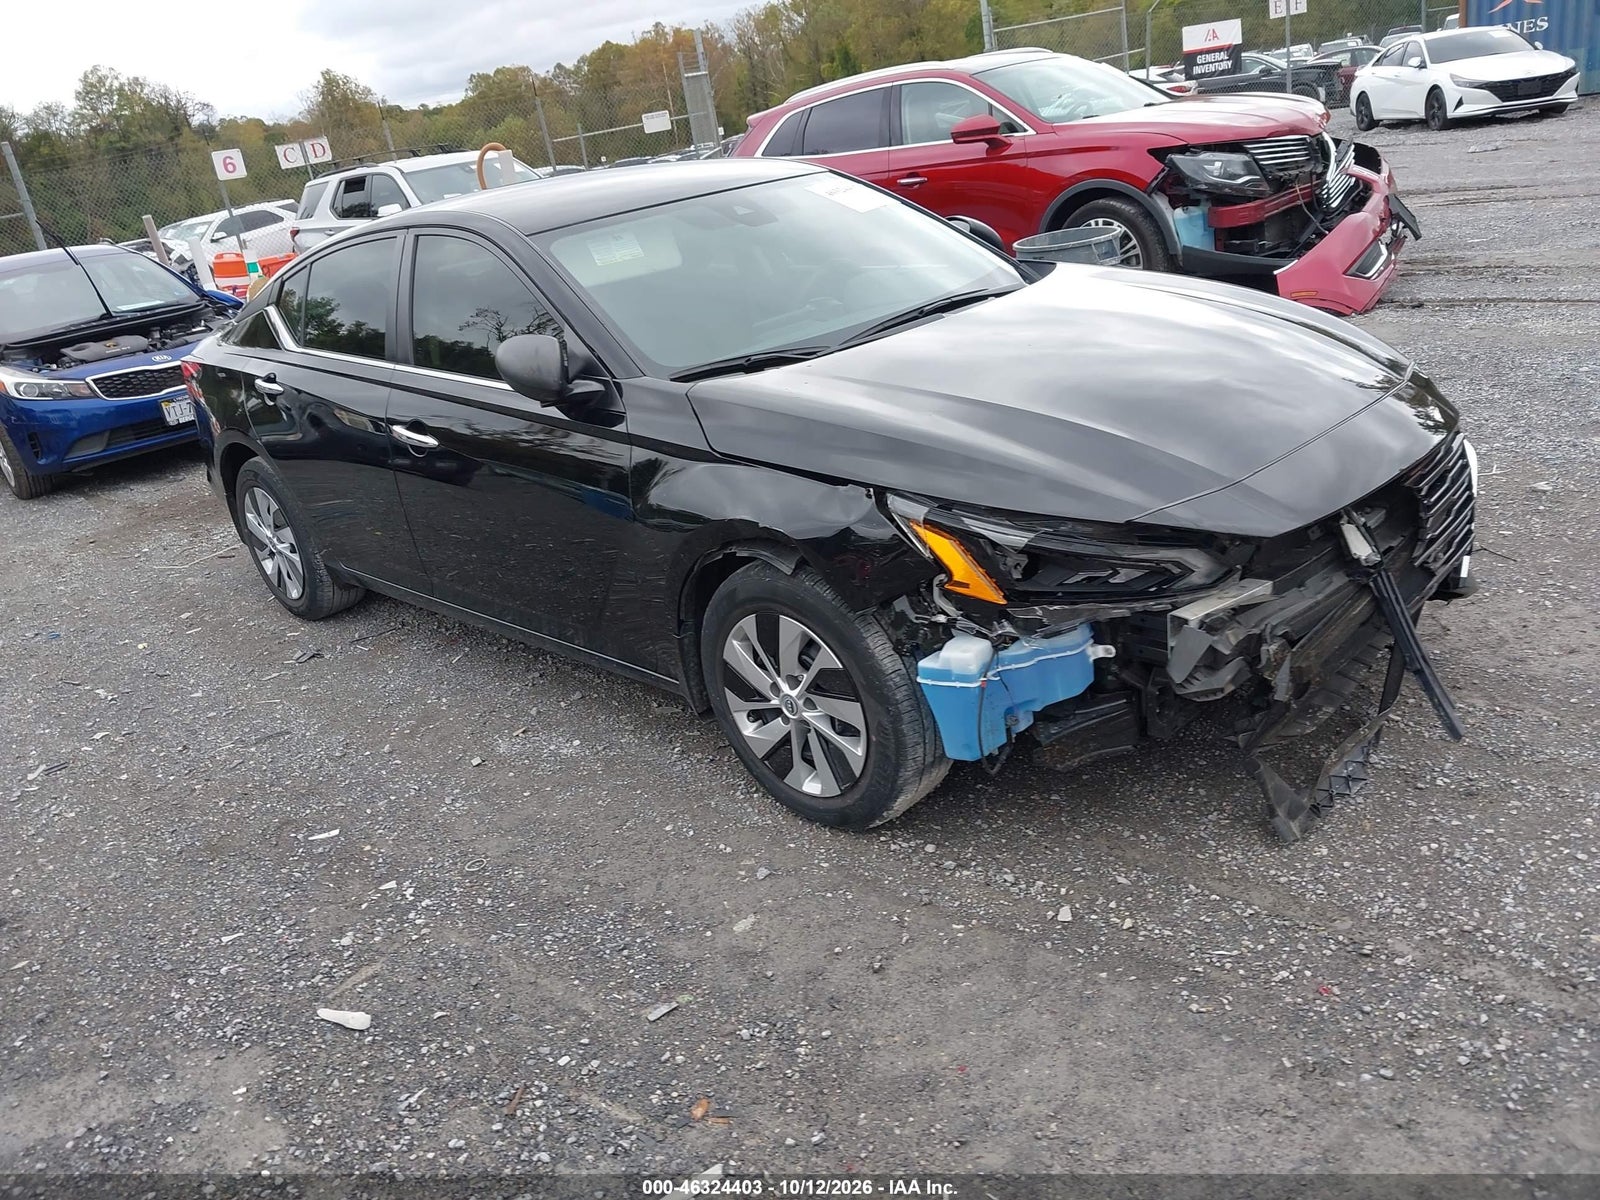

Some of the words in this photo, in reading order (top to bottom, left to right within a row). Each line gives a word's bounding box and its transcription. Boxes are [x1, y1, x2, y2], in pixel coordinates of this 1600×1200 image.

[1274, 0, 1283, 14] E
[1196, 51, 1230, 64] GENERAL
[1192, 60, 1233, 75] INVENTORY
[283, 147, 297, 164] C
[311, 142, 326, 159] D
[222, 155, 237, 174] 6
